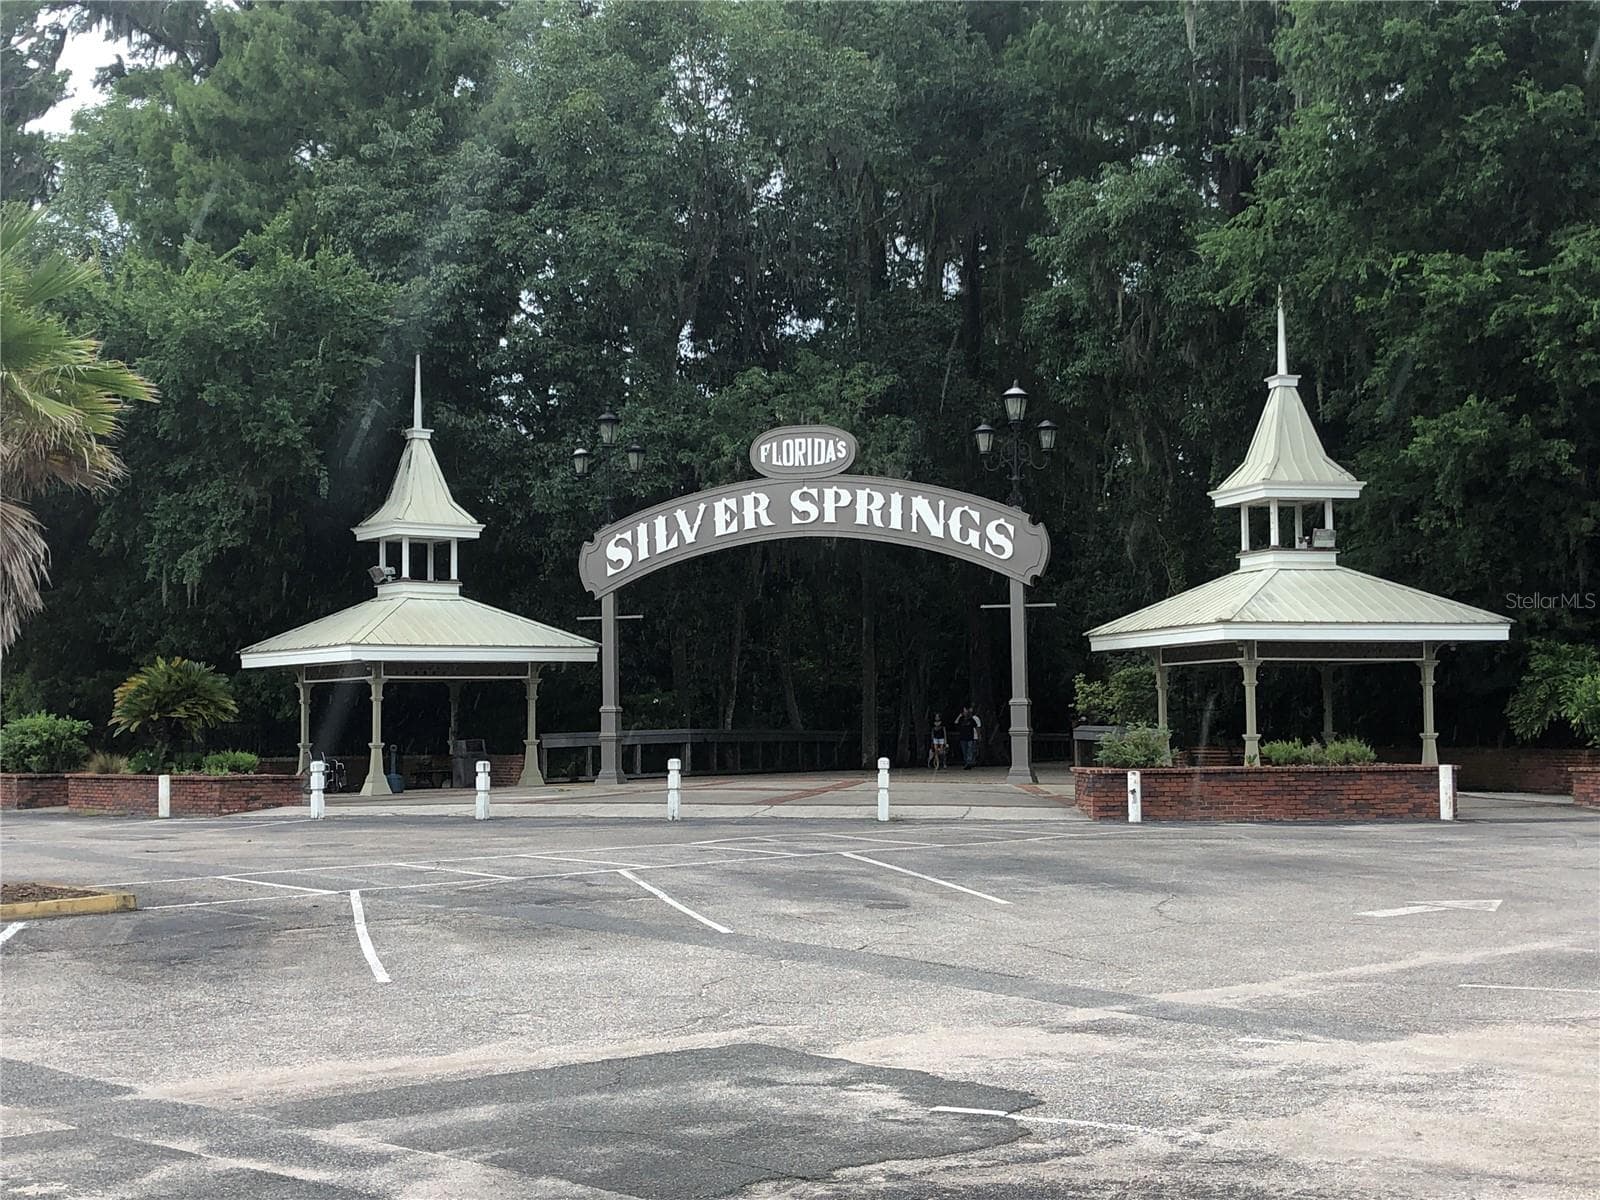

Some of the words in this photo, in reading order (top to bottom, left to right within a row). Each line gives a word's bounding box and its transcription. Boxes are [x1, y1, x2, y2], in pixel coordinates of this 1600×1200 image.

[759, 437, 848, 467] FLORIDA'S
[606, 490, 776, 577] SILVER
[790, 485, 1016, 561] SPRINGS
